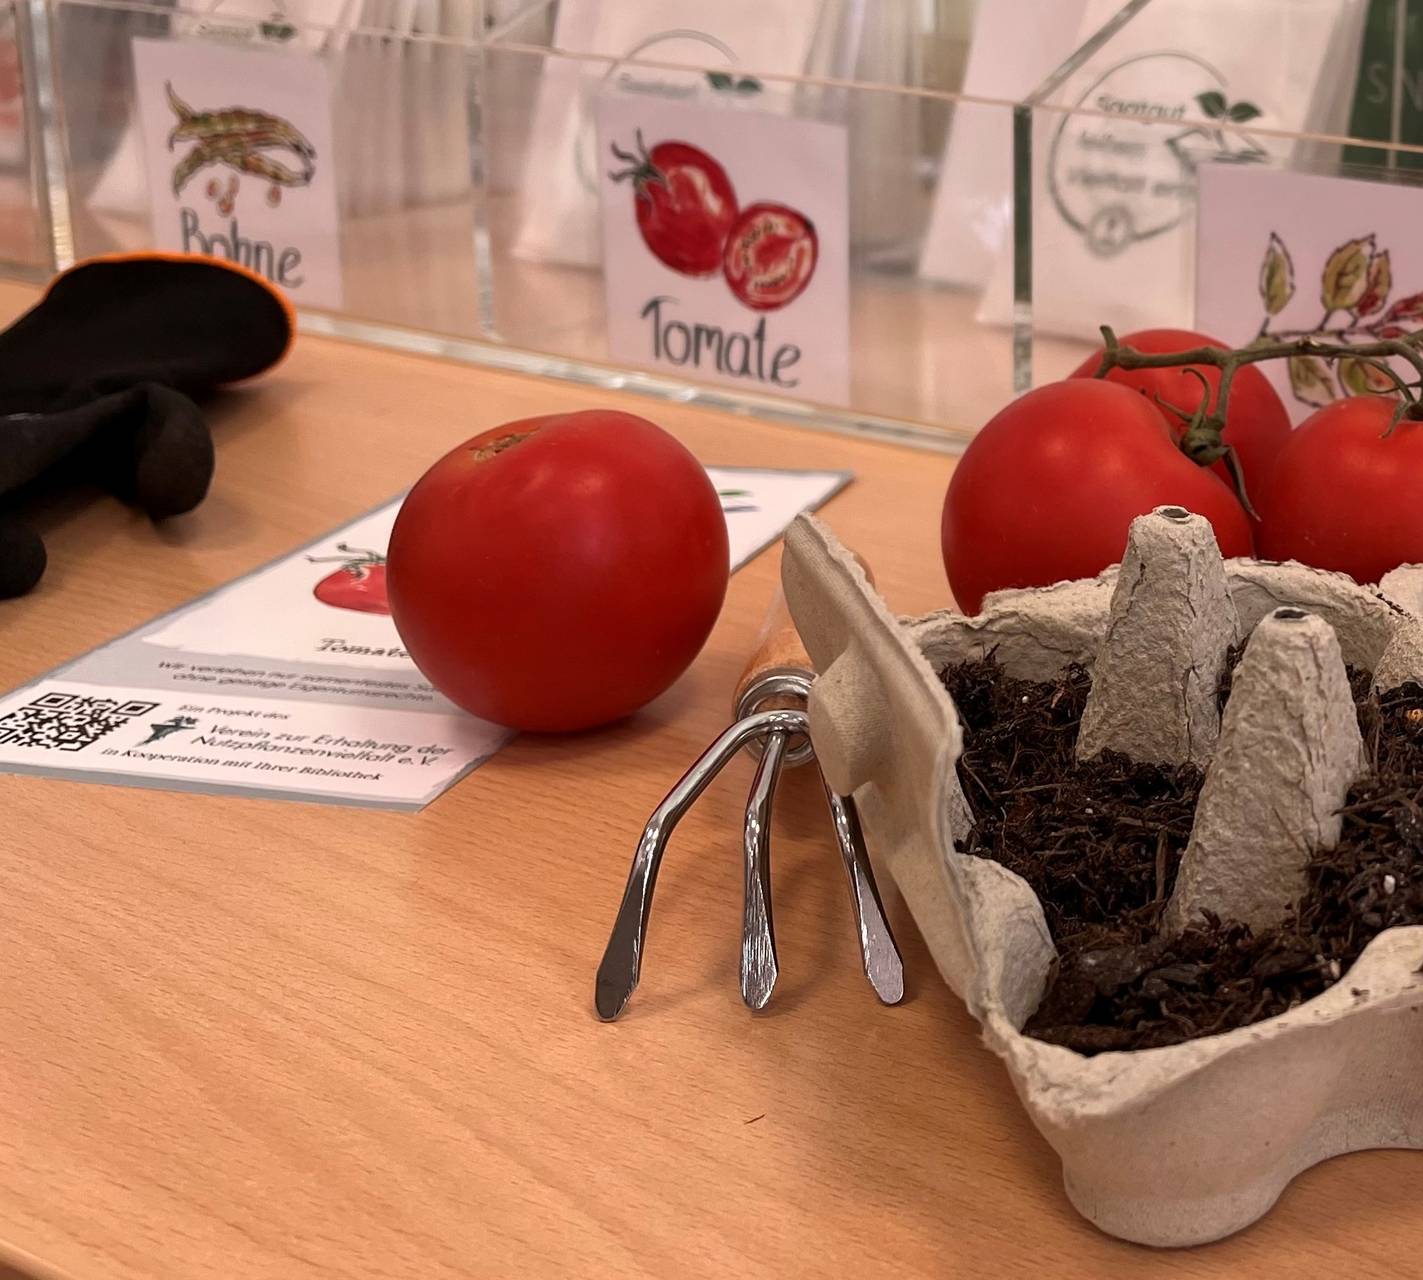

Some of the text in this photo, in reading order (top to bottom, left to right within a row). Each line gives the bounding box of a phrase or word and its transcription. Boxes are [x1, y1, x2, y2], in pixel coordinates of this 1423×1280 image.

[640, 295, 802, 388] Tomate
[189, 735, 396, 764] Nutzpflanzenvielfalt
[210, 723, 454, 755] Verein zur Erhaltung der
[101, 747, 384, 780] in Kooperation mit Ihrer Bibliothek
